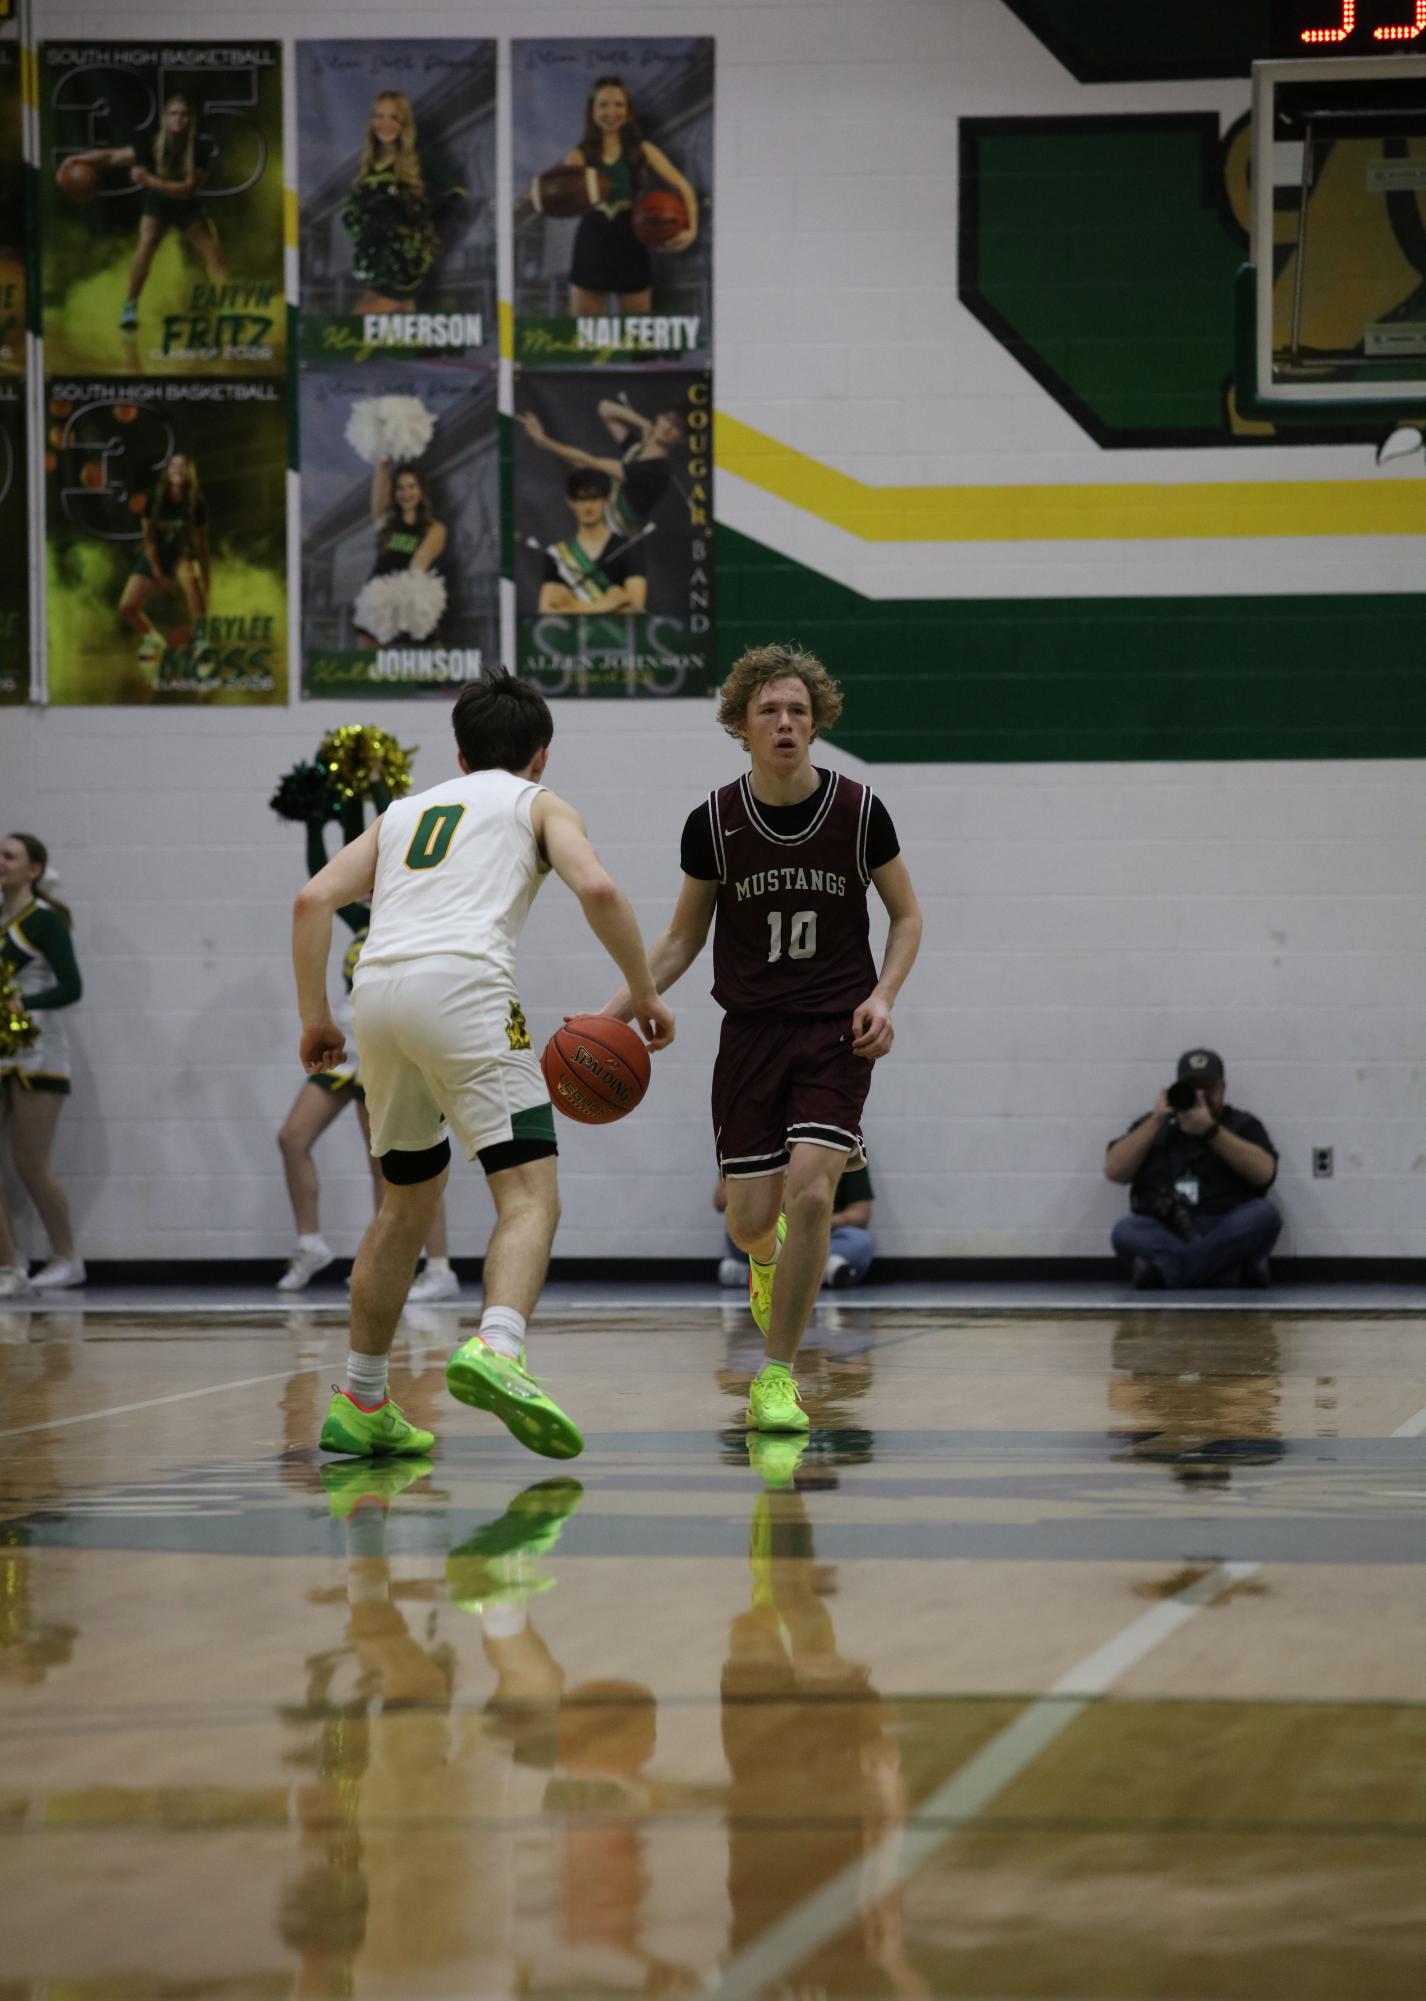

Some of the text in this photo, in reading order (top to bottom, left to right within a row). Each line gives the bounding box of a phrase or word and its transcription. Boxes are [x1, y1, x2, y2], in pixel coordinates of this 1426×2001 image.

[47, 48, 275, 65] SOUTH HIGH BASKETBALL
[163, 315, 273, 356] FRITZ
[363, 314, 482, 347] EMERSON
[576, 316, 700, 350] HALFERTY
[51, 383, 278, 400] SOUTH HIGH BASKETBALL
[687, 383, 709, 526] COUGAR
[689, 539, 710, 634] BAND
[368, 648, 482, 682] JOHNSON
[403, 802, 467, 872] 0
[734, 867, 846, 902] MUSTANGS
[766, 910, 818, 963] 10
[570, 1045, 631, 1103] SPALDING
